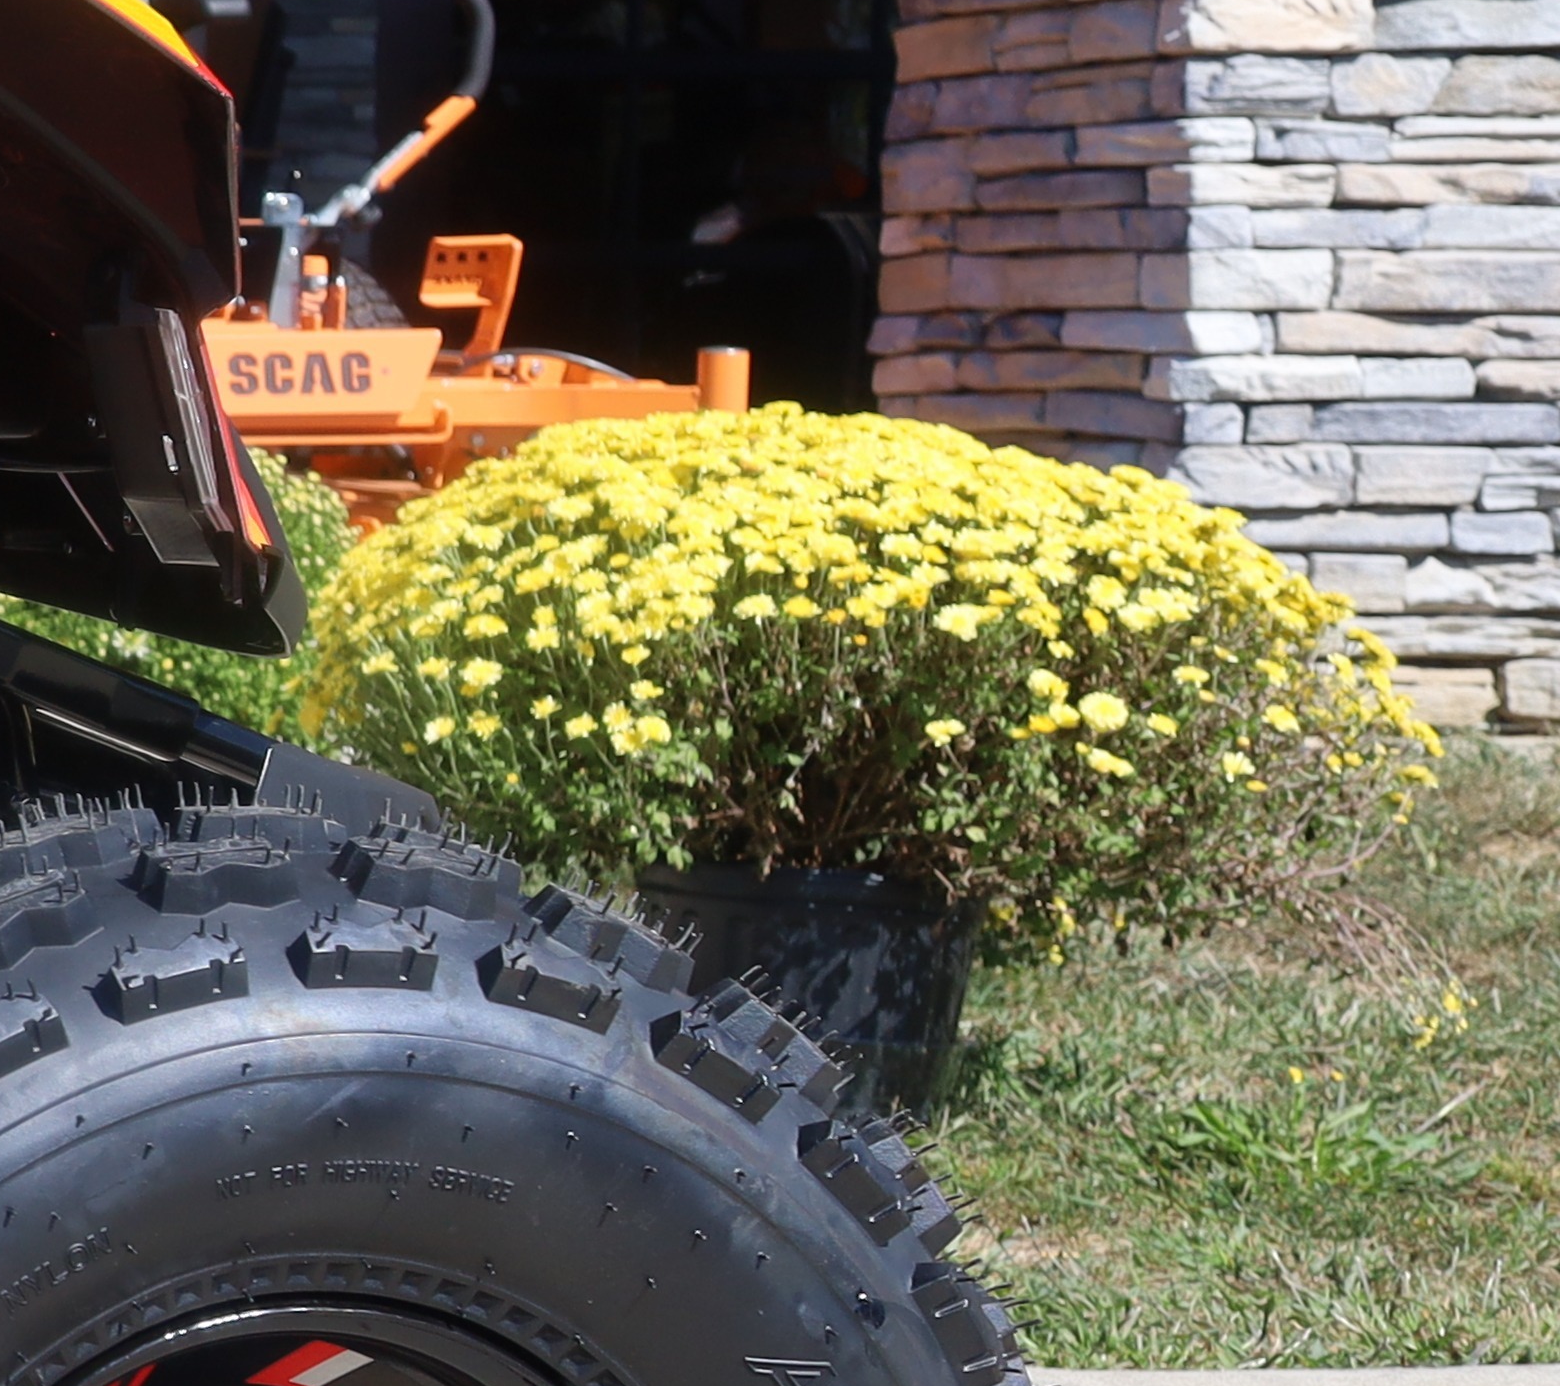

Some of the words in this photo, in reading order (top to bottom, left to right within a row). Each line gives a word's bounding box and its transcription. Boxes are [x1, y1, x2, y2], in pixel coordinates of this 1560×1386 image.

[227, 351, 373, 396] SCAG
[216, 1171, 257, 1201] NOT
[271, 1163, 308, 1188] FOR
[0, 1225, 113, 1318] NYLON
